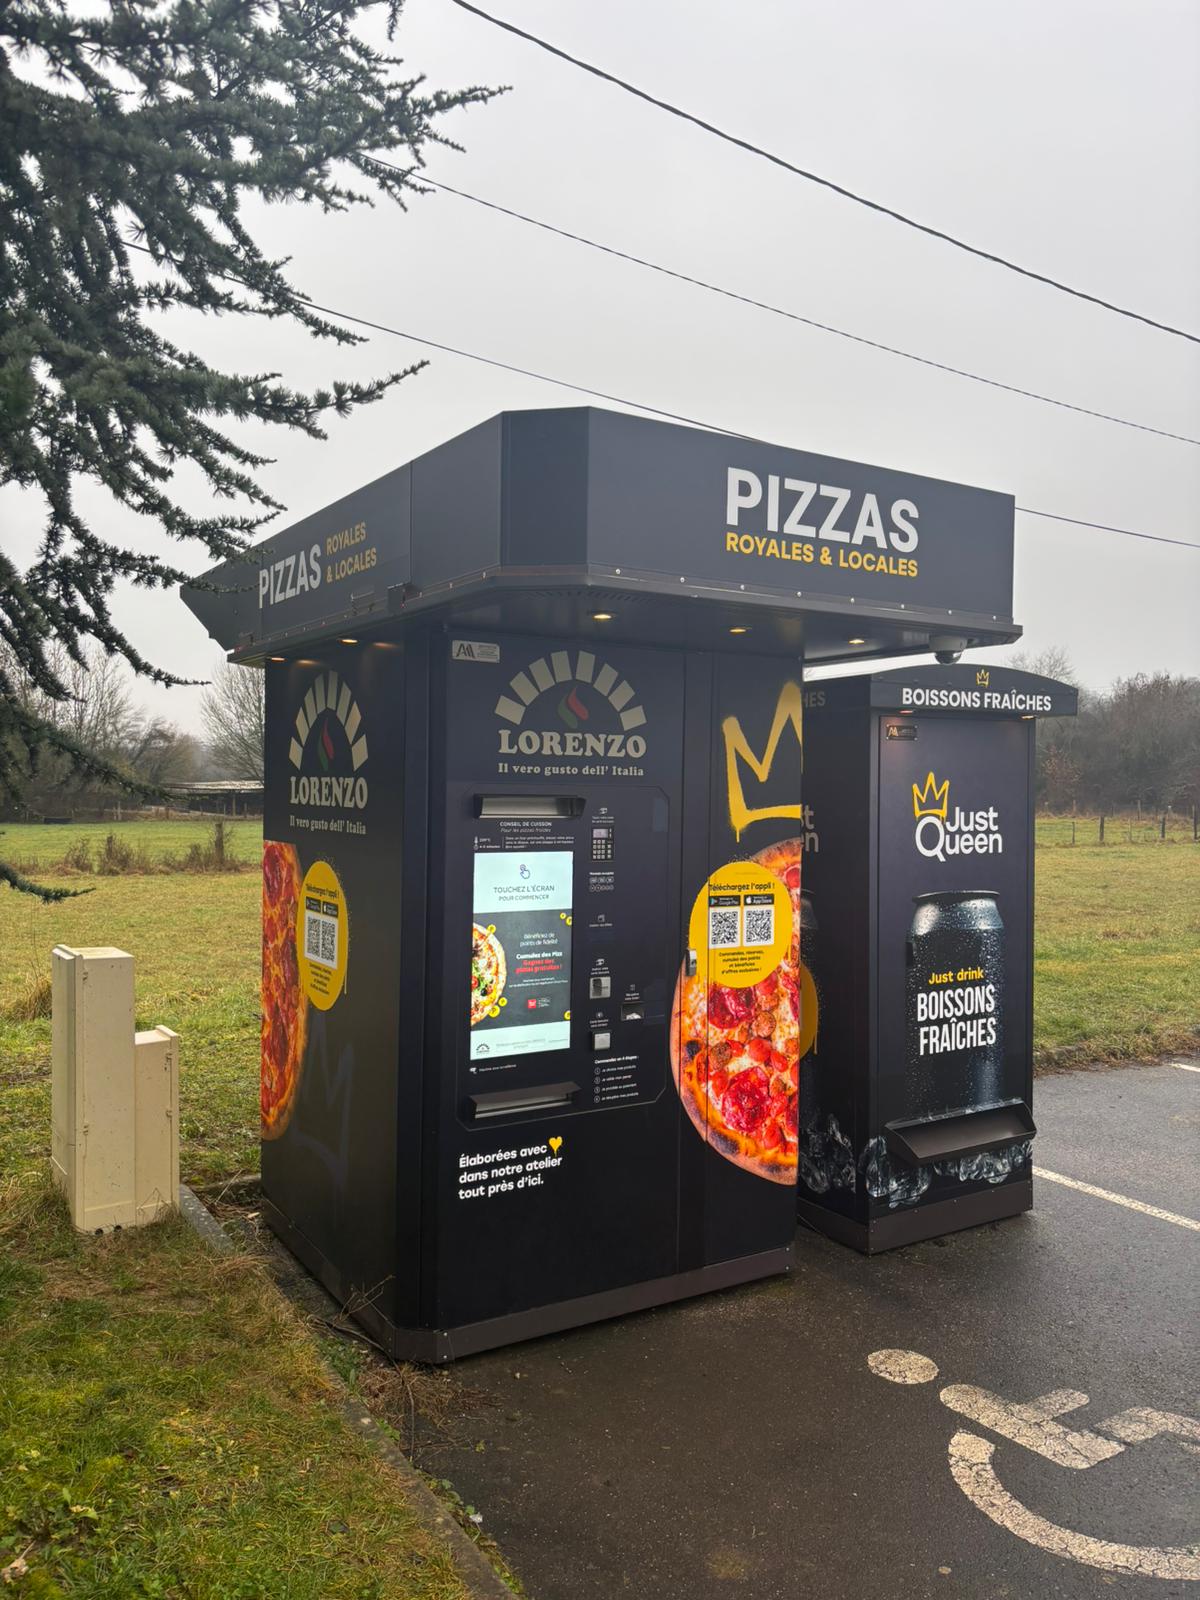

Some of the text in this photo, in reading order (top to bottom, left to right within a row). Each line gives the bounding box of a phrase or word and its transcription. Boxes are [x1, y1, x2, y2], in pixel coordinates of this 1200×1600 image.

[726, 466, 919, 553] PIZZAS
[325, 522, 367, 556] ROYALES
[326, 547, 377, 583] & LOCALES
[726, 532, 919, 577] ROYALES & LOCALES
[259, 543, 322, 609] PIZZAS
[902, 687, 1052, 712] BOISSONS FRAÎCHES
[498, 729, 647, 758] LORENZO
[498, 763, 508, 773] Il
[512, 765, 541, 774] vero
[544, 765, 578, 776] gusto
[612, 766, 644, 776] Italia
[290, 776, 368, 809] LORENZO
[296, 818, 309, 828] vero
[310, 819, 328, 831] gusto
[346, 820, 366, 835] Italia
[946, 806, 999, 832] Just
[915, 815, 1003, 862] Queen
[494, 885, 526, 893] TOUCHEZ
[928, 967, 984, 985] Just drink
[917, 984, 996, 1022] BOISSONS
[919, 1017, 997, 1056] FRAÎCHES
[459, 1144, 547, 1168] Élaborées avec
[459, 1156, 562, 1184] dans notre atelier
[458, 1173, 544, 1200] tout près d'ici.
